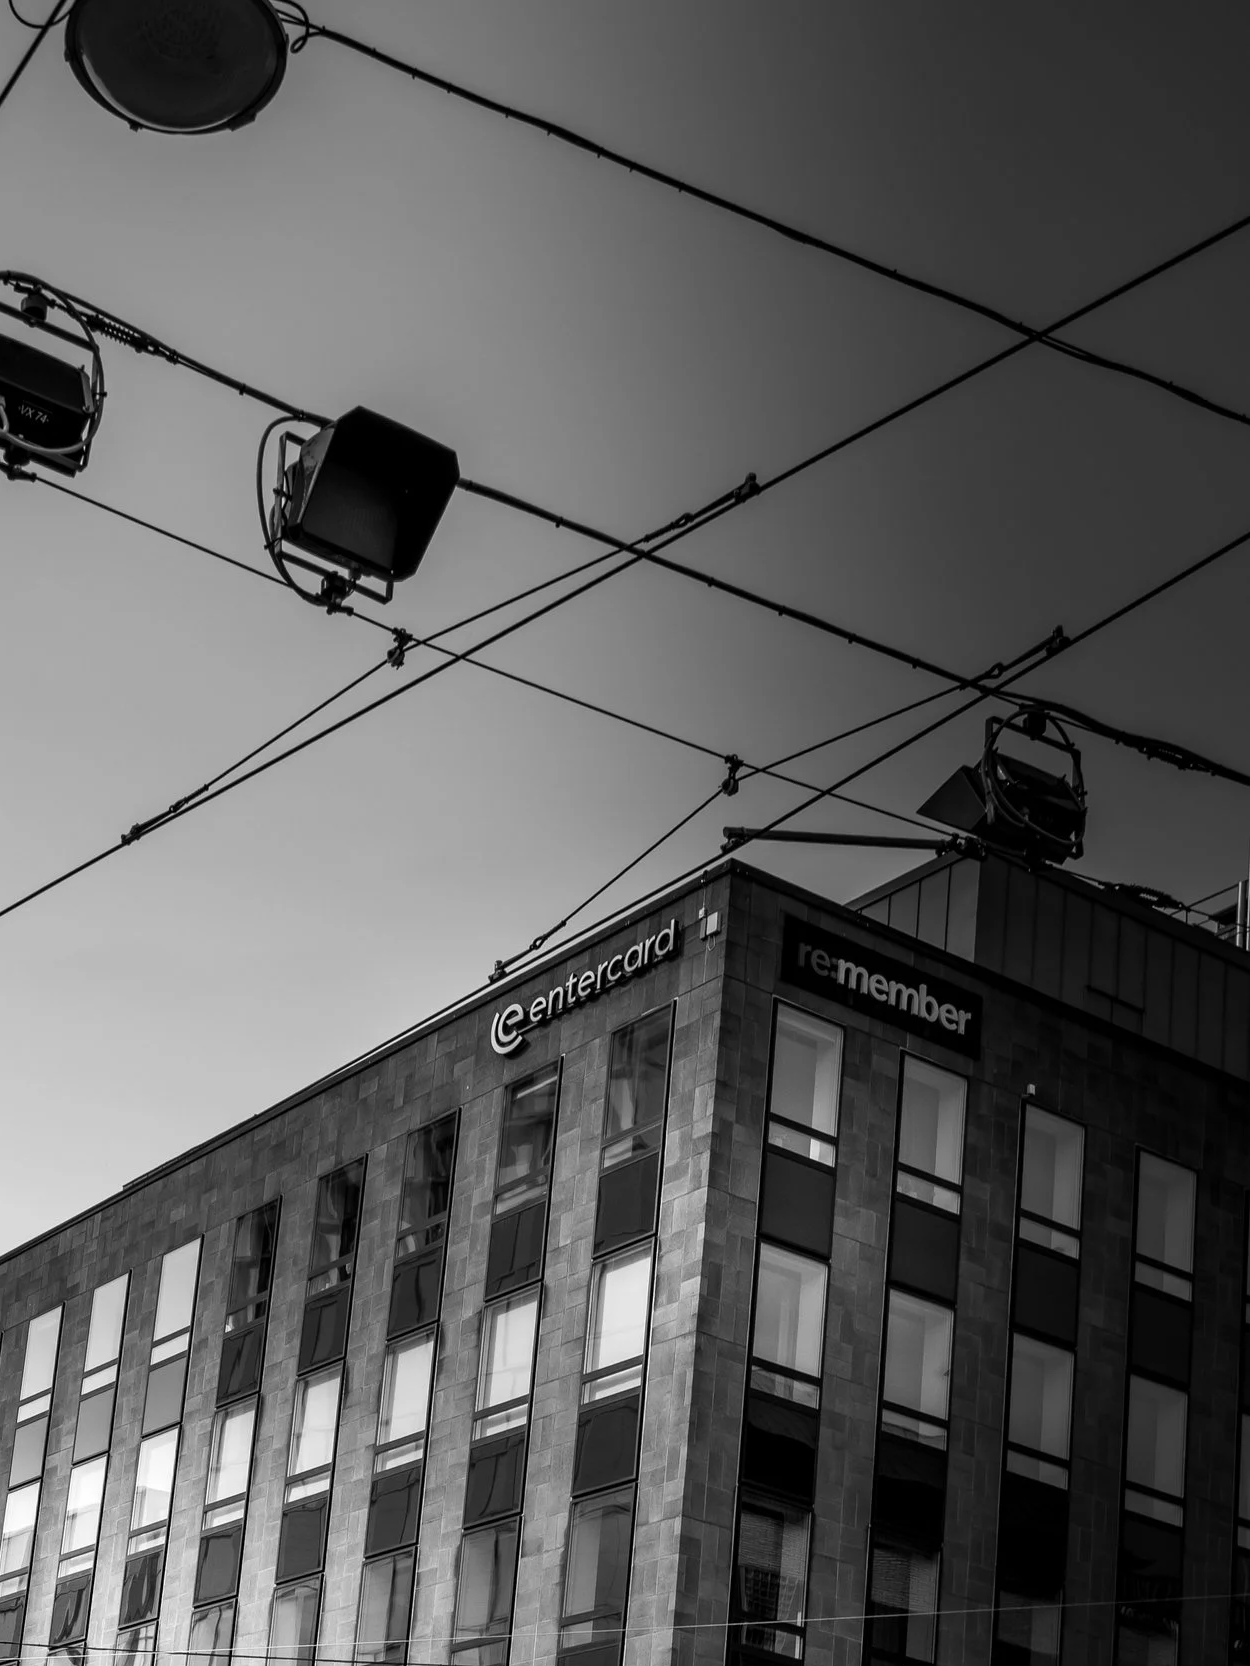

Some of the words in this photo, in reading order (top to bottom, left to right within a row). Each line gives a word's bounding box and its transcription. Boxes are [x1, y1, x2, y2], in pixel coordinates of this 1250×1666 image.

[21, 404, 35, 419] VX
[529, 918, 675, 1023] entercard
[797, 942, 972, 1036] re:member
